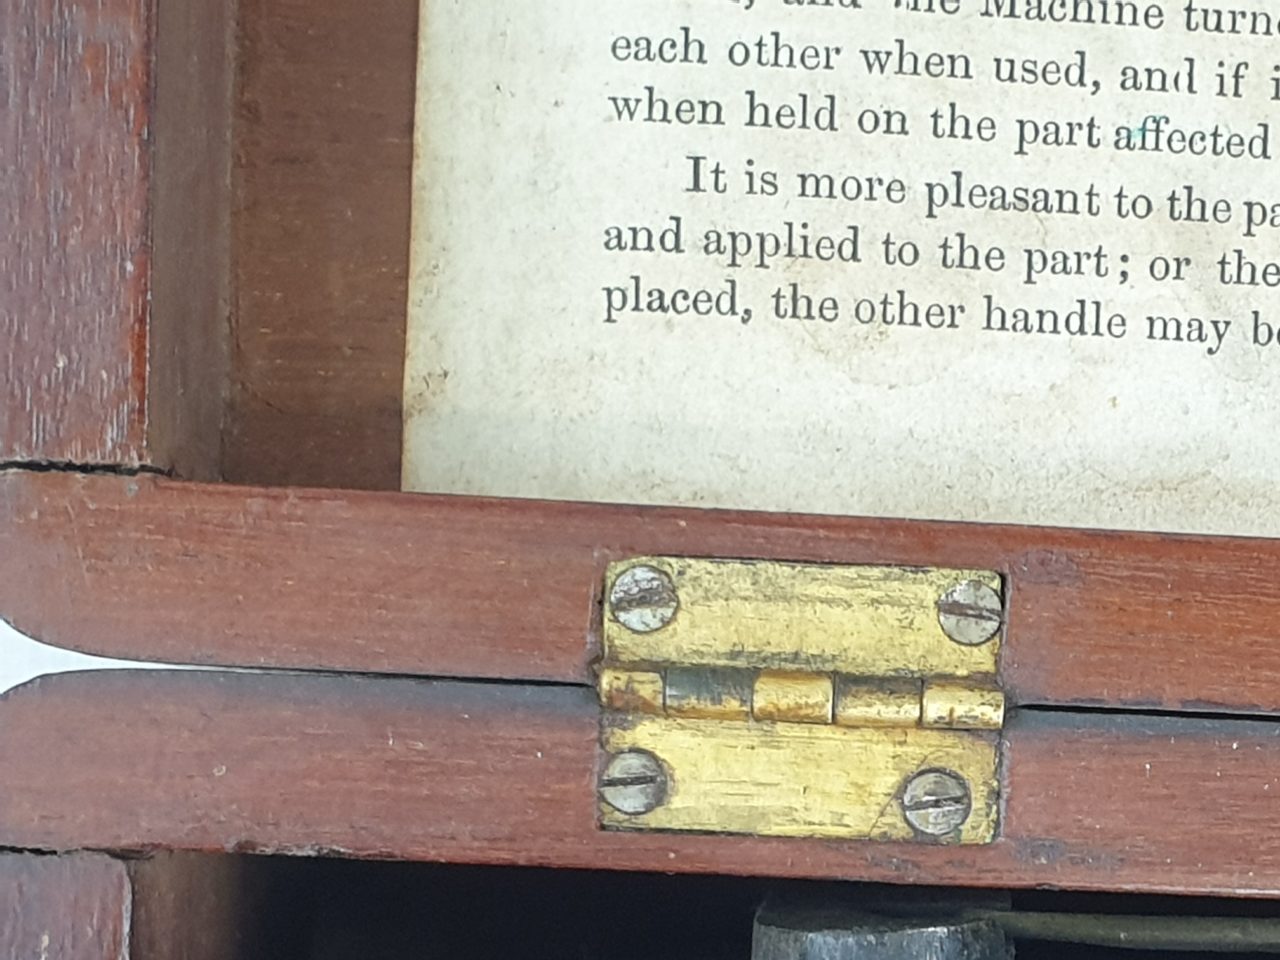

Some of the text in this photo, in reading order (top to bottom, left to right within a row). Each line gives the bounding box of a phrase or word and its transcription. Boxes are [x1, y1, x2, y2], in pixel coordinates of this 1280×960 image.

[980, 0, 1164, 30] Machine
[611, 26, 708, 64] each
[728, 31, 842, 70] other
[859, 39, 973, 79] when
[993, 50, 1100, 96] used,
[1120, 57, 1197, 94] and
[1215, 60, 1249, 98] if
[608, 86, 725, 125] when
[744, 90, 838, 132] held
[858, 109, 909, 136] on
[930, 102, 996, 142] the
[1014, 116, 1101, 156] part
[1114, 115, 1271, 160] affected
[684, 155, 727, 194] It
[745, 159, 778, 196] is
[797, 173, 906, 203] more
[924, 171, 1100, 225] pleasant
[1114, 185, 1153, 219] to
[1166, 185, 1232, 224] the
[604, 215, 685, 254] and
[702, 221, 862, 269] applied
[882, 232, 920, 266] to
[938, 232, 1005, 272] the
[1023, 245, 1129, 285] part;
[1149, 256, 1191, 281] or
[601, 275, 752, 325] placed,
[771, 282, 839, 322] the
[855, 290, 965, 329] other
[981, 294, 1126, 338] handle
[1146, 316, 1231, 356] may
